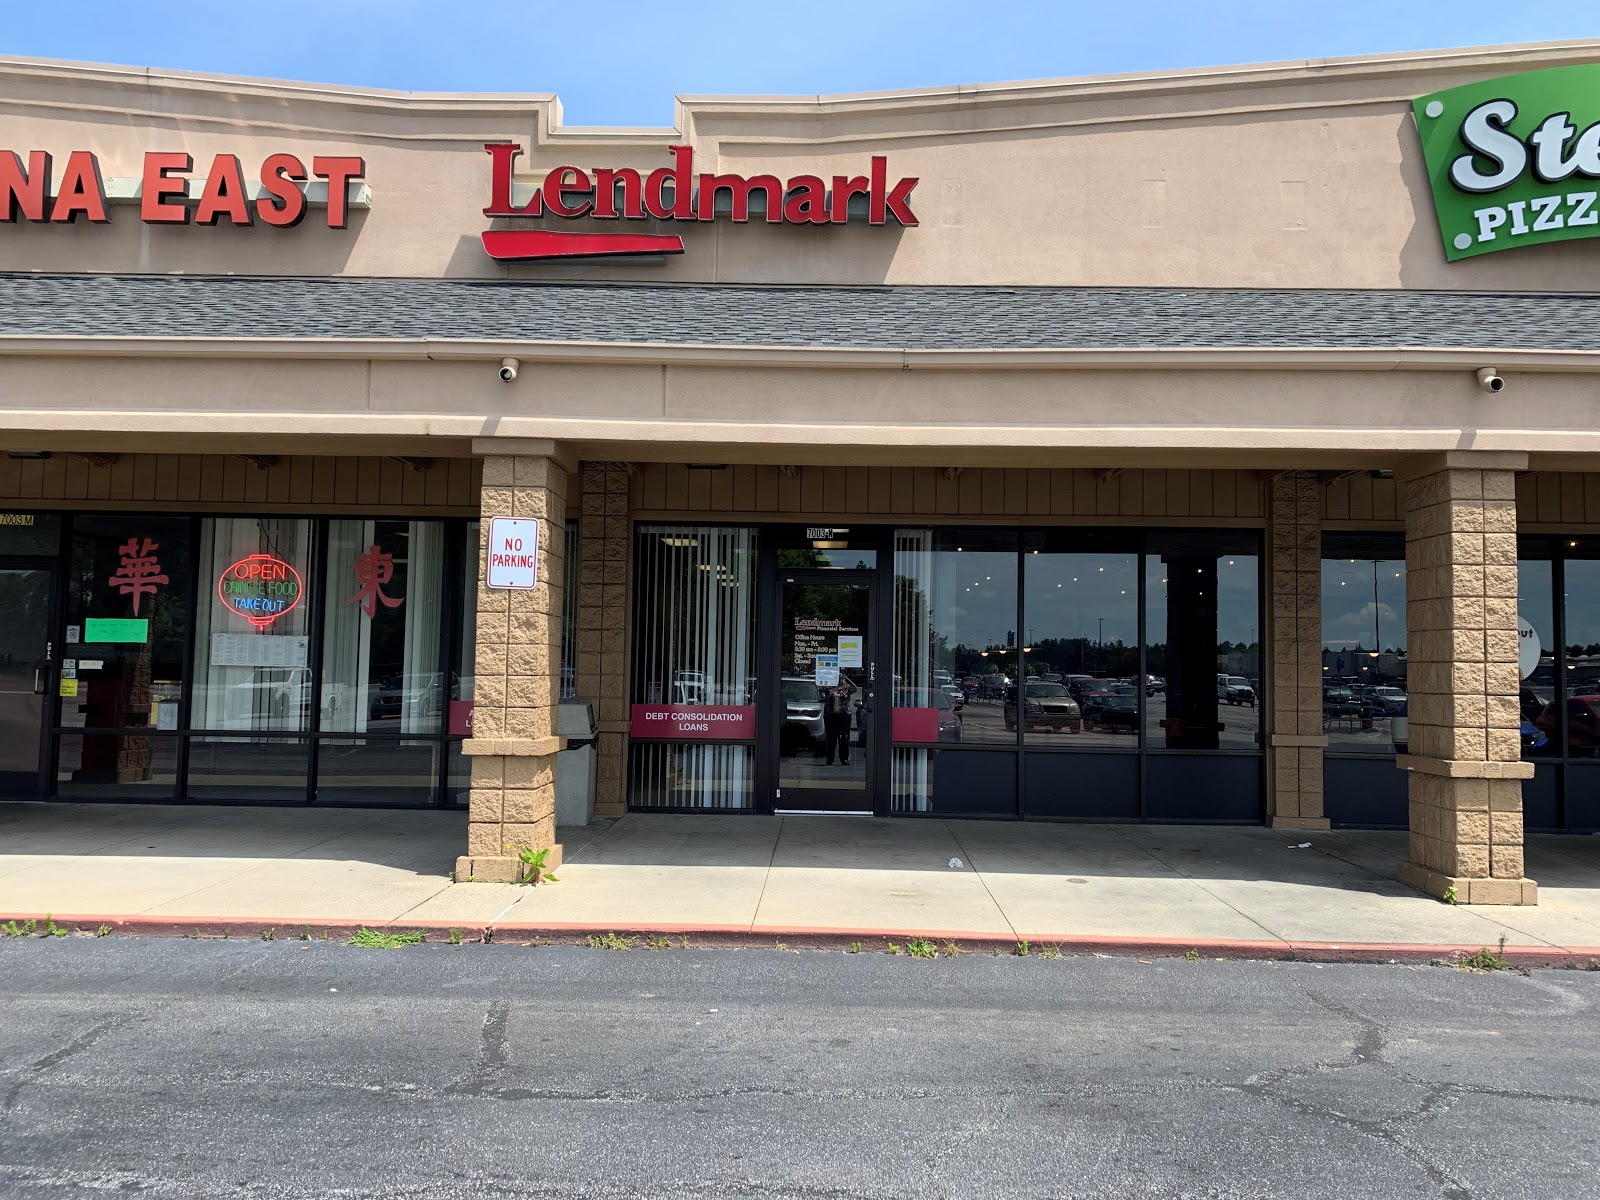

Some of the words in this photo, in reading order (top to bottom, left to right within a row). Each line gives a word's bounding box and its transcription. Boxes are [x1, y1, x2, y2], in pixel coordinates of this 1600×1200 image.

[141, 151, 366, 230] EAST
[483, 144, 919, 227] Lendmark
[1, 514, 23, 525] 7003
[24, 515, 33, 525] M
[505, 538, 523, 551] NO
[492, 553, 534, 568] PARKING
[108, 537, 169, 617] 華
[234, 563, 286, 580] OPEN
[223, 580, 266, 595] CHINESE
[268, 582, 298, 596] FOOD
[342, 545, 405, 619] 東
[234, 597, 260, 610] TAKE
[262, 598, 285, 612] OUT
[794, 617, 841, 627] Lendmark
[1518, 628, 1534, 638] ut
[645, 712, 669, 720] DEBT
[671, 712, 743, 721] CONSOLIDATION
[679, 723, 709, 731] LOANS
